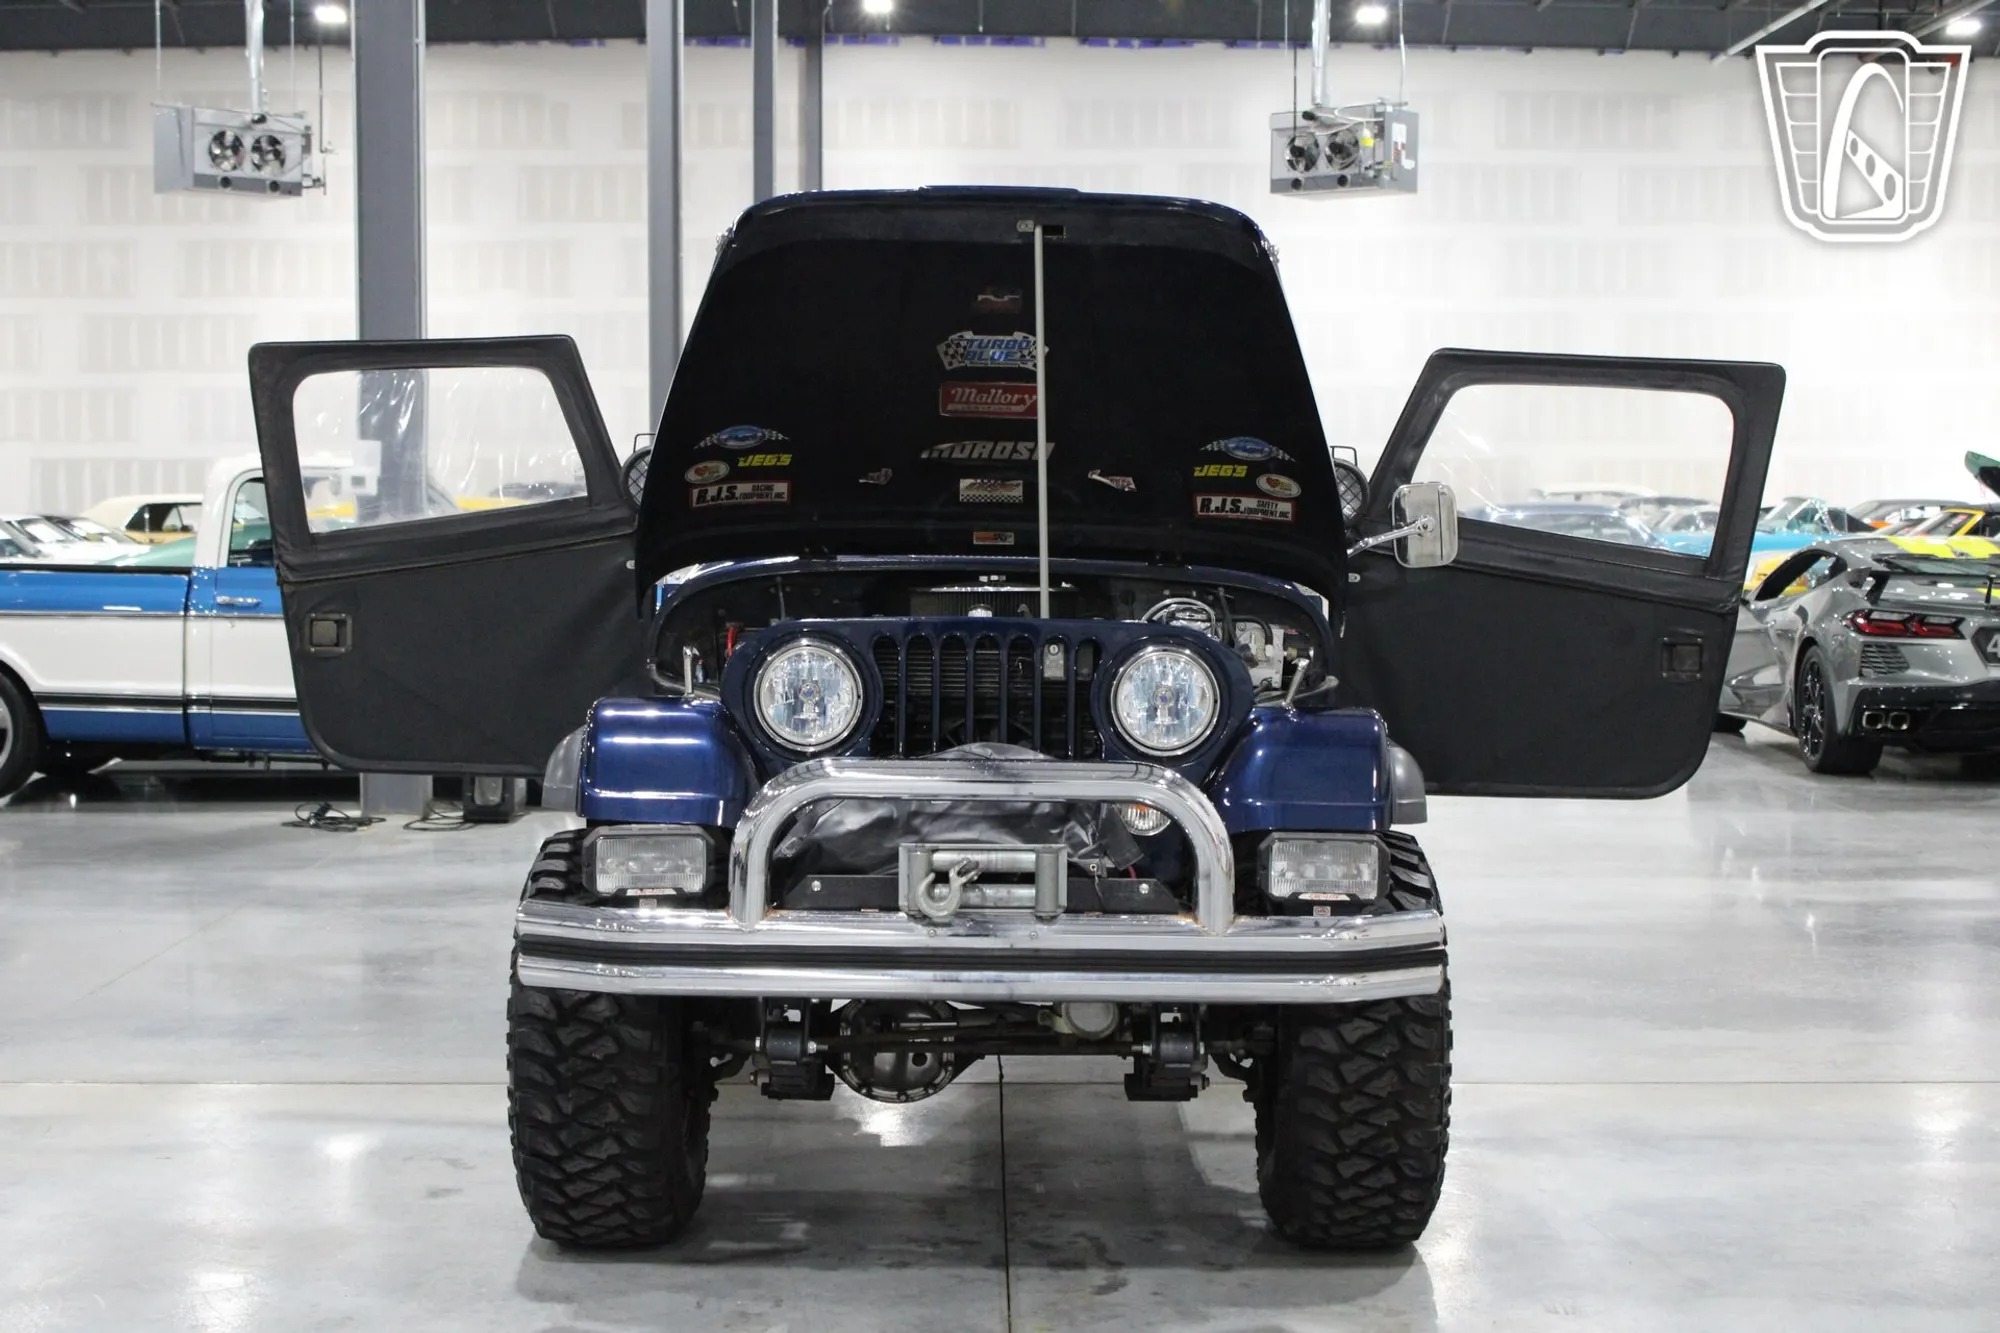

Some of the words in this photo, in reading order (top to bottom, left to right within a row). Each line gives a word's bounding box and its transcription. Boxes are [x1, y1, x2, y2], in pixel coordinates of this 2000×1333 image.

[966, 338, 1031, 350] TURBO
[965, 351, 1018, 361] BLUE
[951, 387, 1037, 408] Mallory
[695, 485, 739, 505] R.J.S.
[1199, 497, 1244, 514] R.J.S.
[1256, 499, 1279, 509] SAFETY
